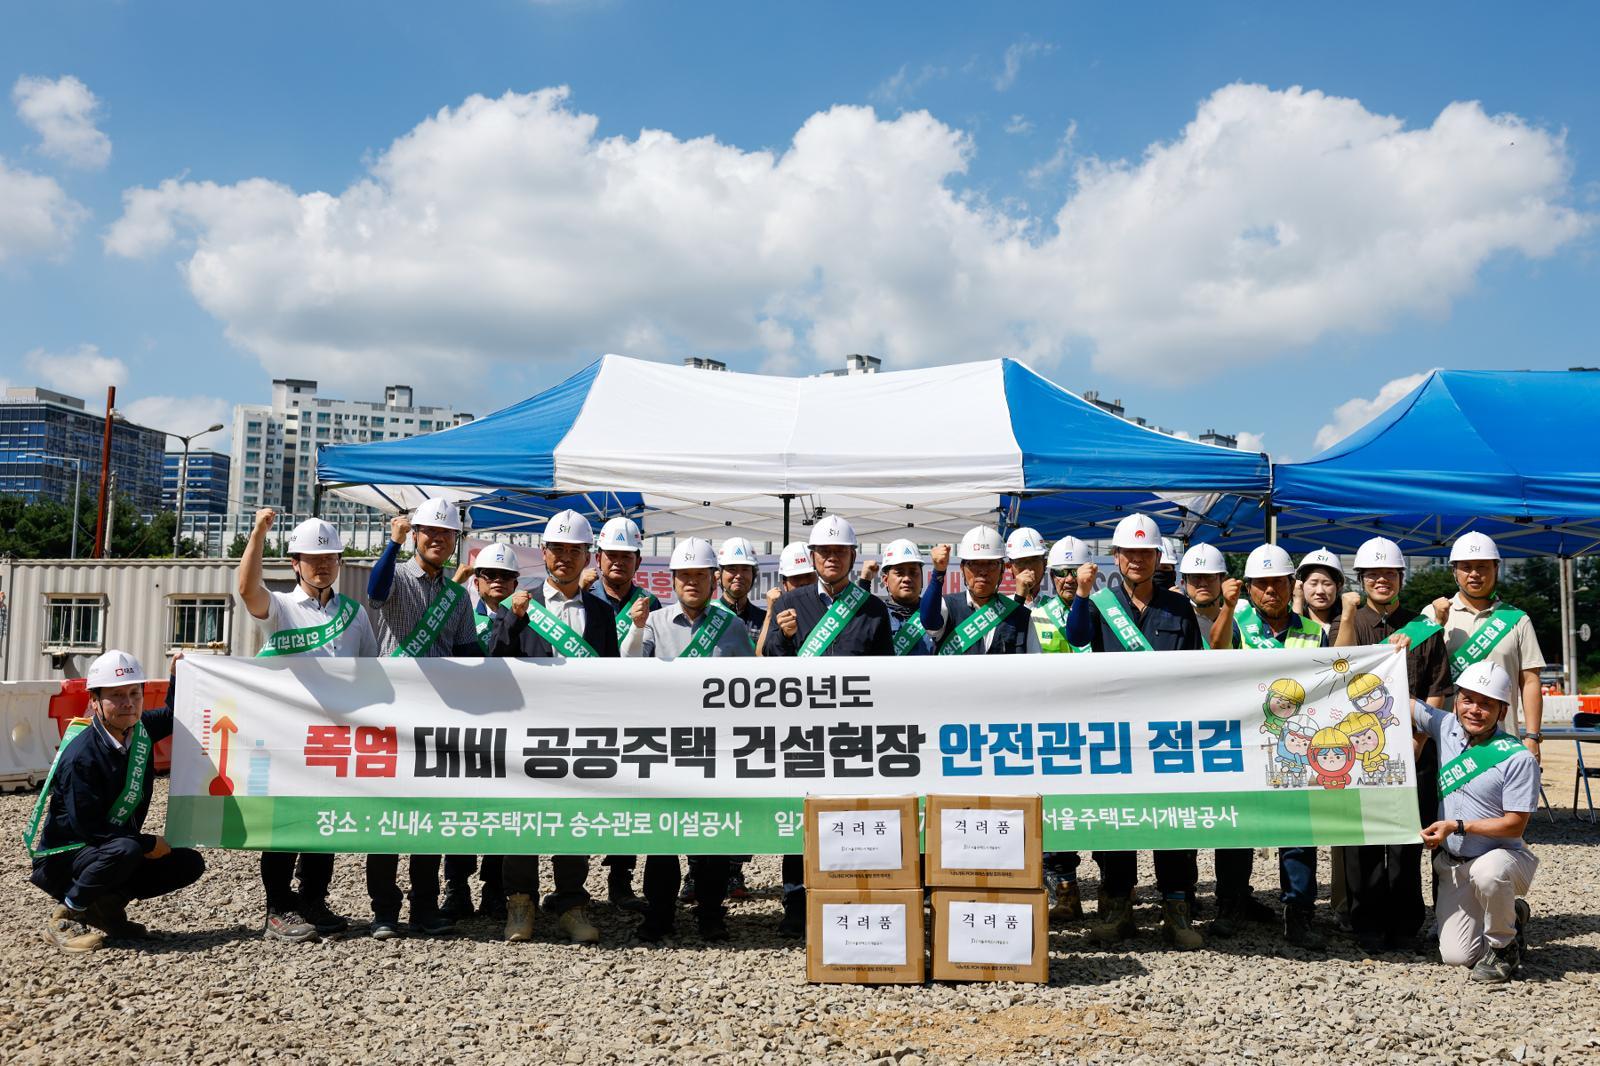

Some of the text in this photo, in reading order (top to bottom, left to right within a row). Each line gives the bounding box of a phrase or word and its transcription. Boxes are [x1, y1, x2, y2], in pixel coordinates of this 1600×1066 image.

[702, 675, 874, 709] 2026년도
[304, 719, 1245, 779] 폭염 대비 공공주택 건설현장 안전관리 점검
[316, 810, 358, 836] 장소
[365, 815, 371, 832] :
[378, 810, 434, 836] 신내4
[438, 811, 564, 837] 공공주택지구
[569, 811, 653, 838] 송수관로
[659, 811, 743, 837] 이설공사
[1042, 805, 1239, 831] 서울주택도시개발공사
